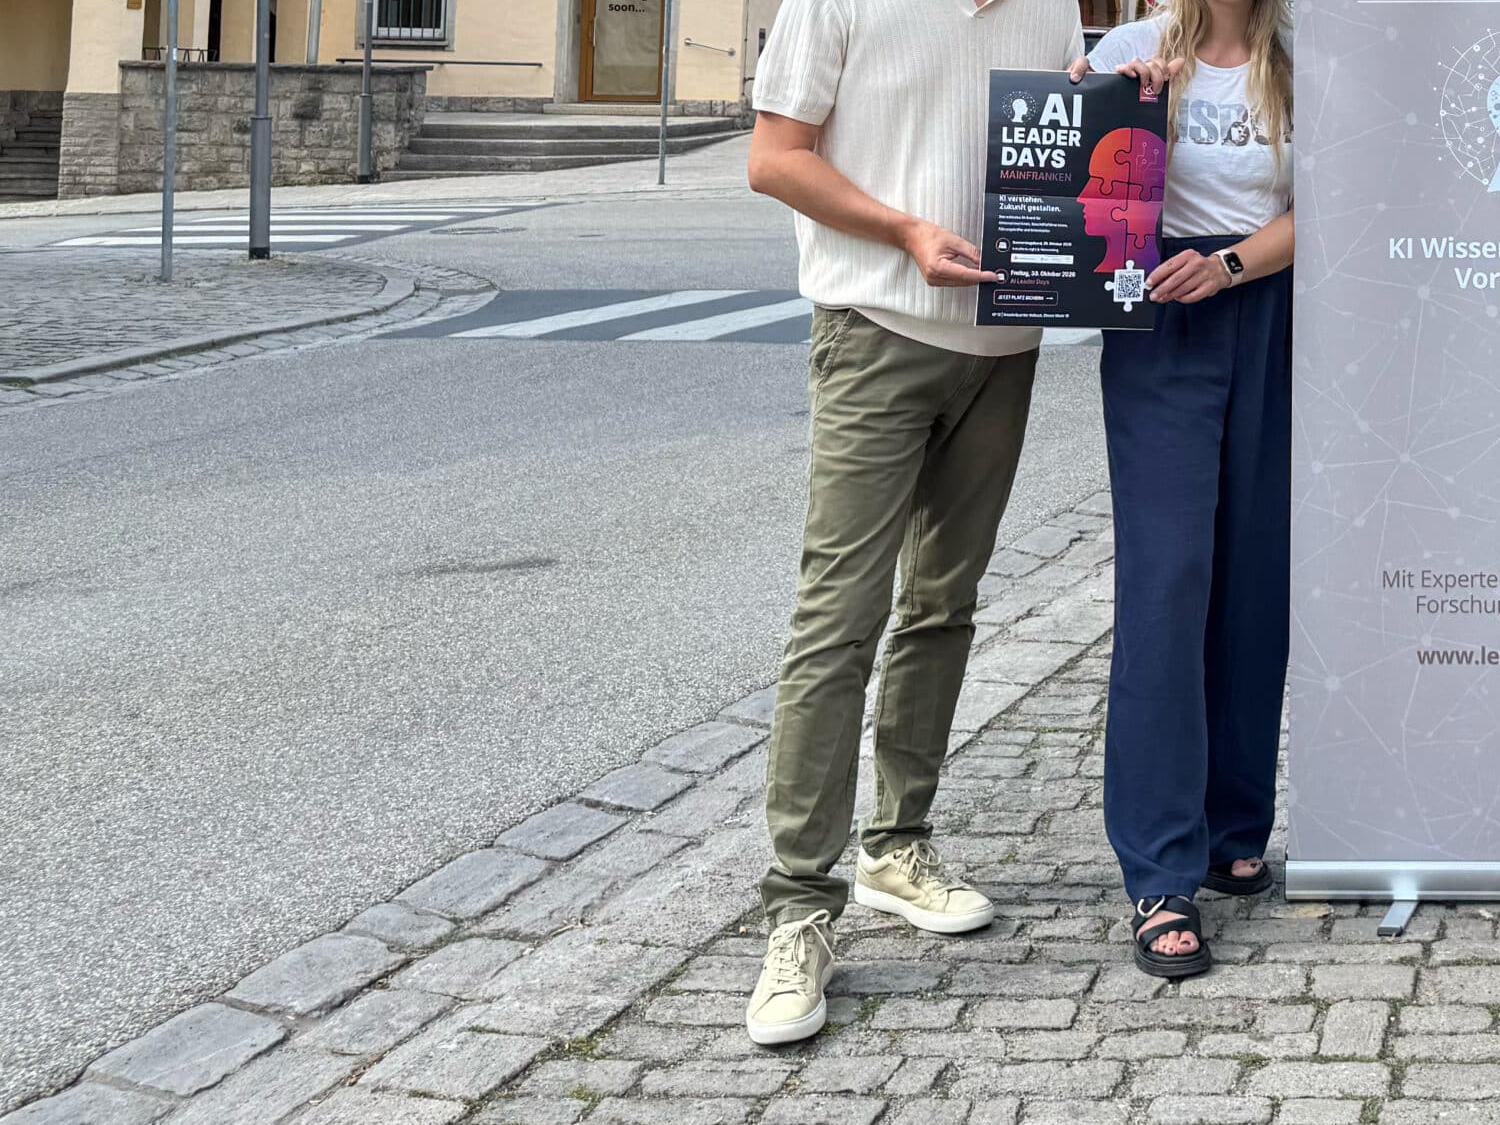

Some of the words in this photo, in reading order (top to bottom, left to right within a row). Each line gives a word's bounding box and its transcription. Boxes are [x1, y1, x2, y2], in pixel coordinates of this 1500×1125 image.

[1038, 93, 1083, 128] AI
[1002, 127, 1081, 147] LEADER
[1001, 146, 1066, 169] DAYS
[1000, 170, 1072, 182] MAINFRANKEN
[1390, 237, 1413, 259] KI
[1382, 569, 1414, 589] Mit
